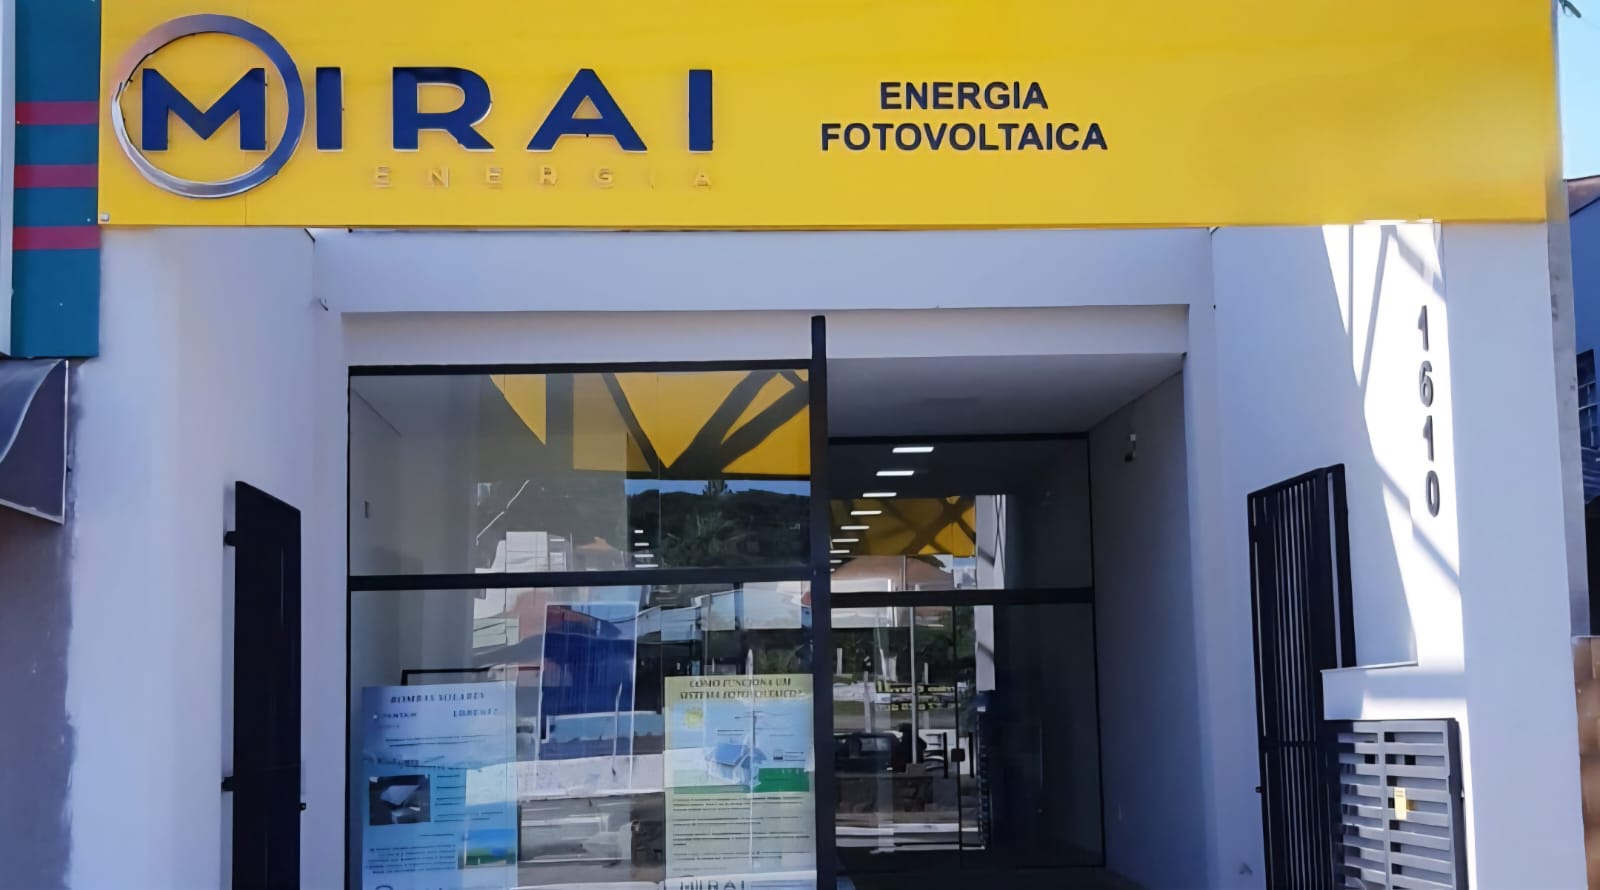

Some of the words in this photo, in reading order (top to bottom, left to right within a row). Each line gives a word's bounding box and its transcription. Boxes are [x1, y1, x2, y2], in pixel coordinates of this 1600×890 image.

[141, 66, 714, 151] MIRAI
[880, 81, 1049, 110] ENERGIA
[821, 122, 1109, 151] FOTOVOLTAICA
[375, 165, 712, 189] ENERGIA
[1417, 304, 1441, 518] 1610
